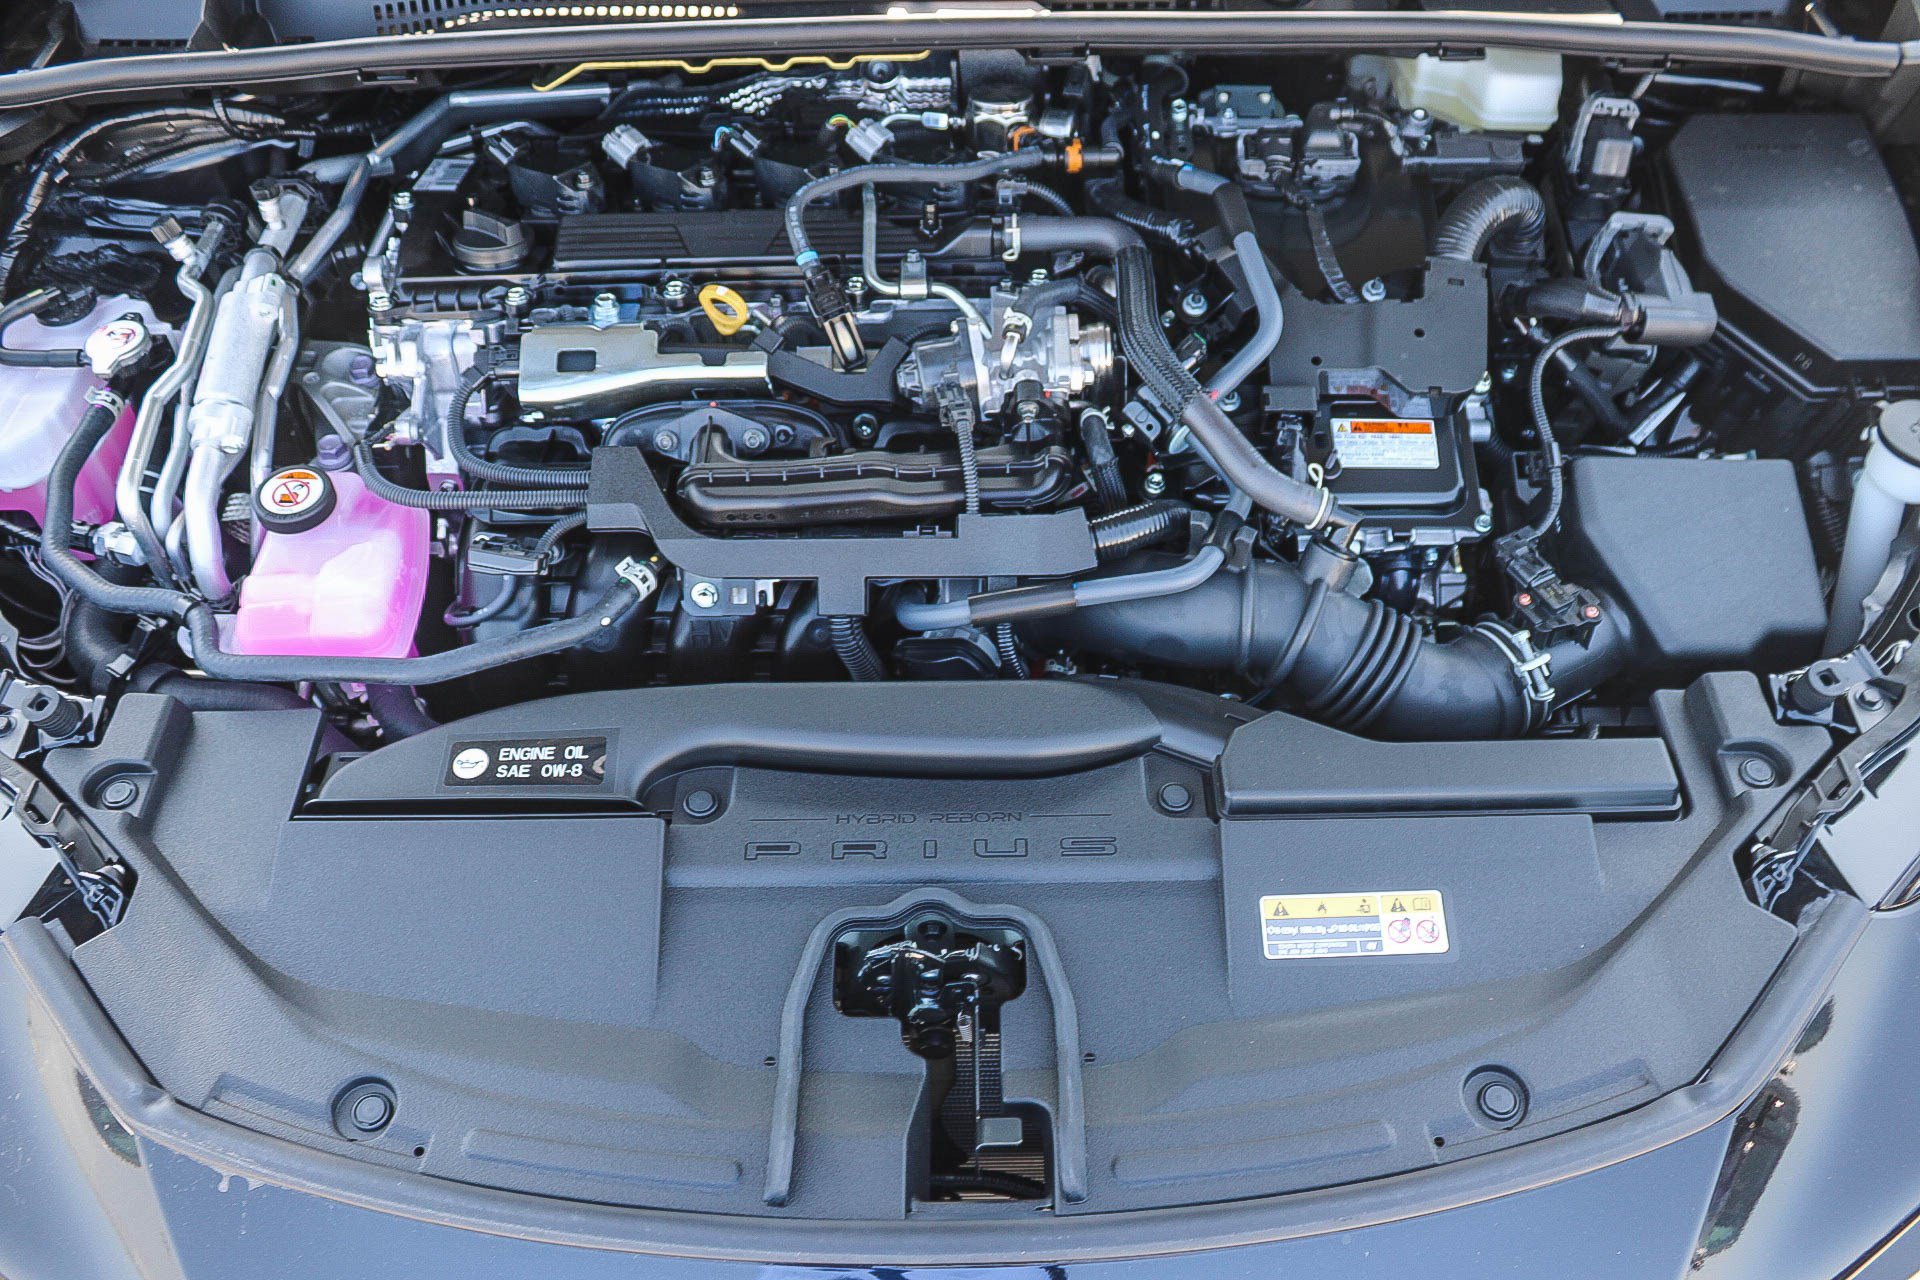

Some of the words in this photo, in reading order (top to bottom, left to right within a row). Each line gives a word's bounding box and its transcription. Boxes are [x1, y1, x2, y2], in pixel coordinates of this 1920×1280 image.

[498, 746, 556, 761] ENGINE
[564, 745, 589, 760] OIL
[495, 764, 532, 778] SAE
[540, 763, 584, 778] 0W-8
[835, 813, 917, 825] HYBRID
[929, 811, 1023, 824] REBORN
[744, 836, 1118, 860] PRIUS
